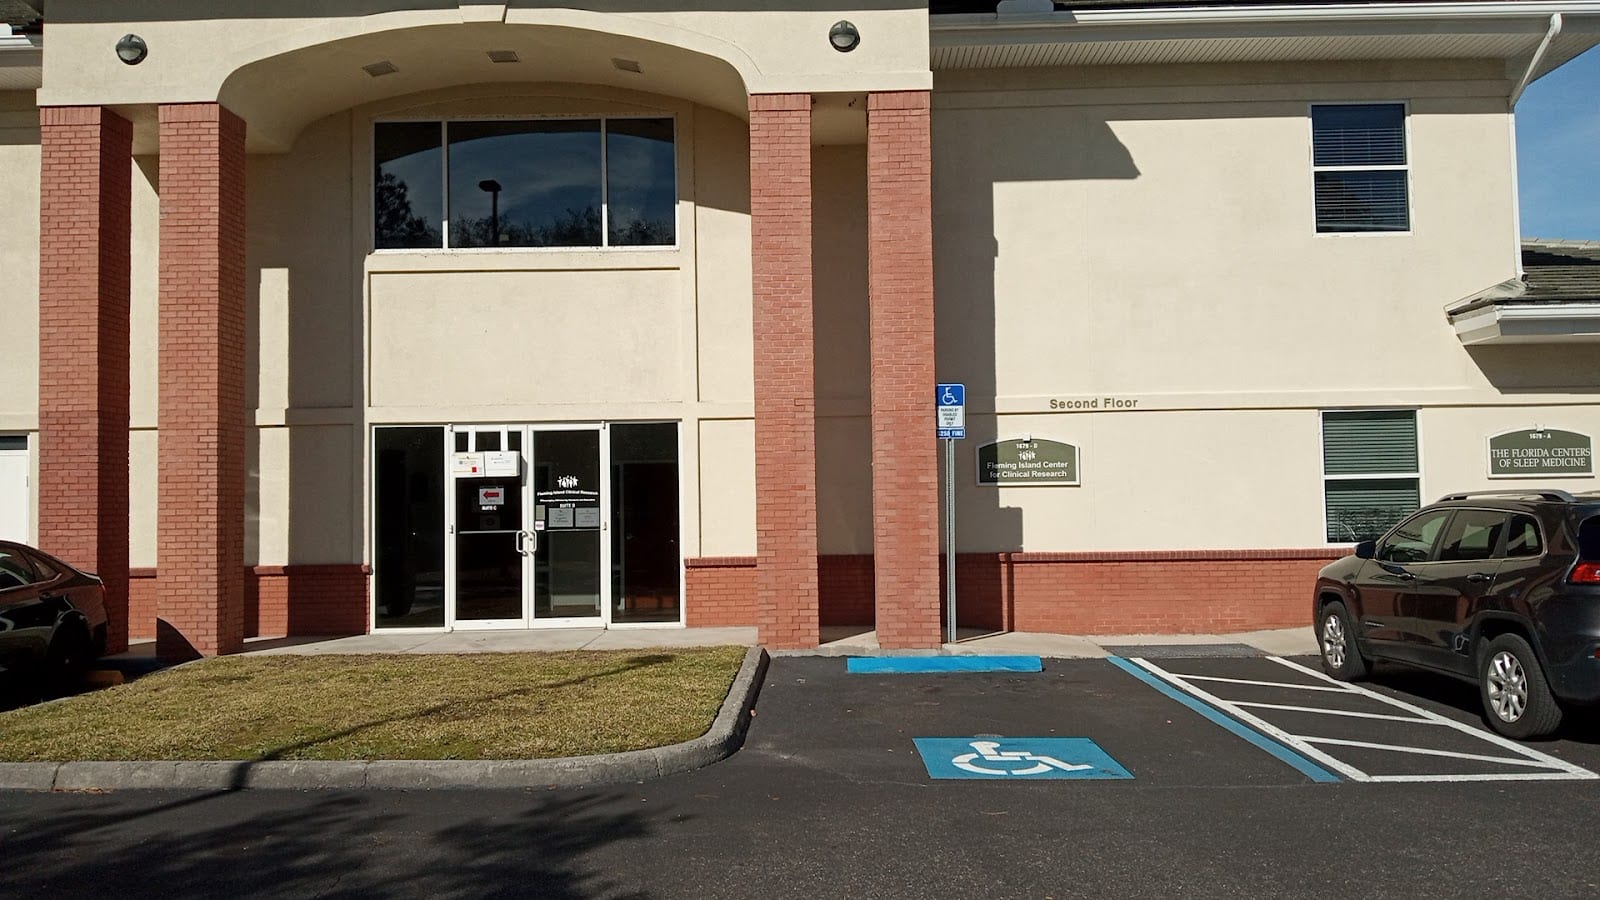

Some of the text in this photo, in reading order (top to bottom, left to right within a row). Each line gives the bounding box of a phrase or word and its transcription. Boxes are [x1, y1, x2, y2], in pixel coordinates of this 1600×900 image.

[1050, 398, 1138, 409] Second Floor
[1491, 447, 1591, 458] THE FLORIDA CENTERS
[986, 460, 1068, 470] Fleming Island Center
[1499, 457, 1586, 468] OF SLEEP MEDICINE
[990, 469, 1067, 478] for Clinical Research
